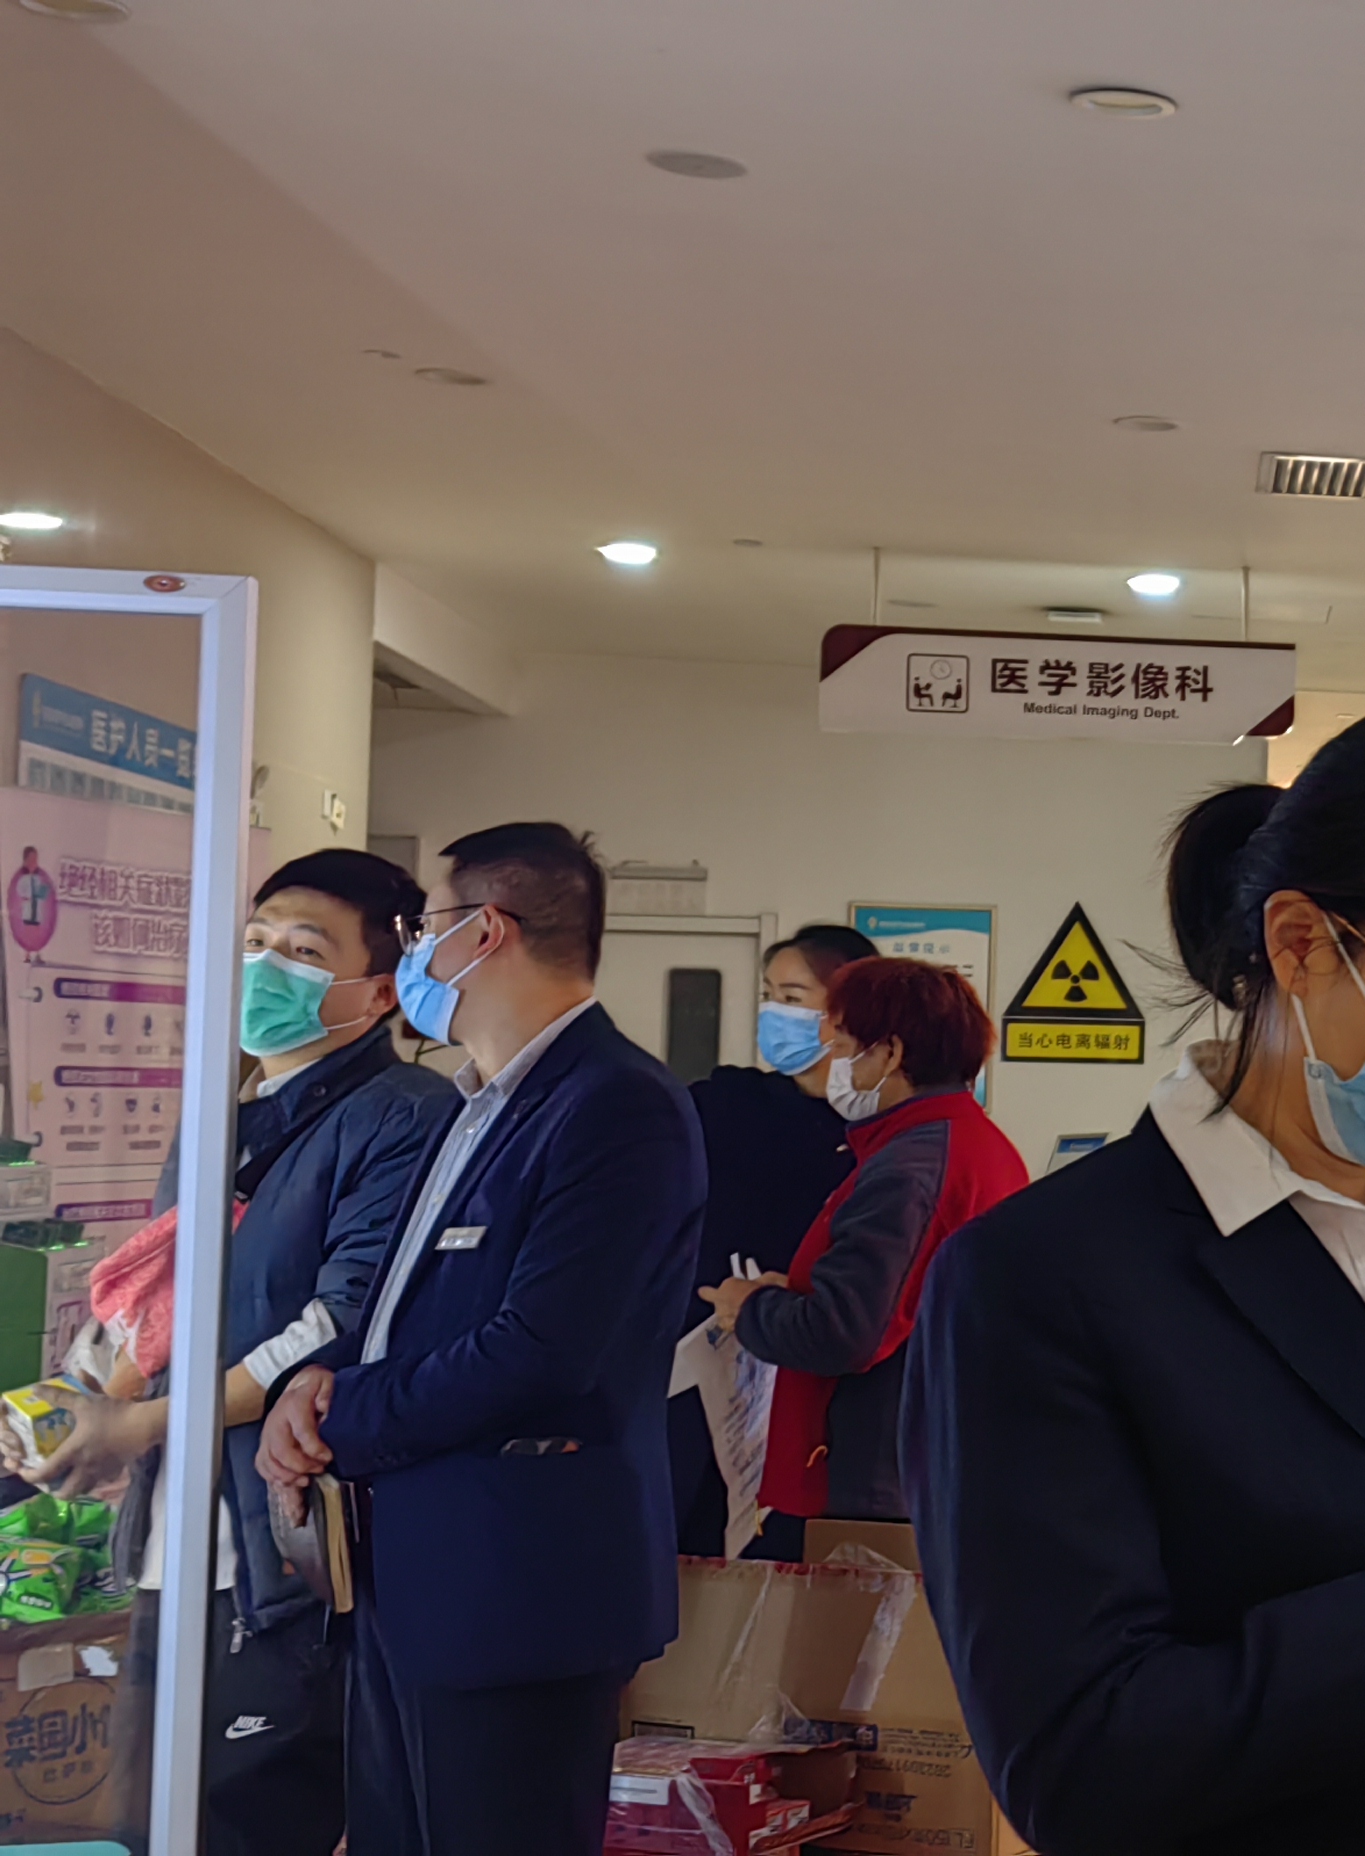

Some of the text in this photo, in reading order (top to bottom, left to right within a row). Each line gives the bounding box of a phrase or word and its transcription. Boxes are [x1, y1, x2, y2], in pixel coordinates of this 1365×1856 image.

[990, 657, 1214, 702] 医学影像科
[1023, 701, 1180, 720] Medical Imaging Dept.
[1018, 1032, 1130, 1050] 当心电离辐射
[233, 1715, 267, 1729] NIKE
